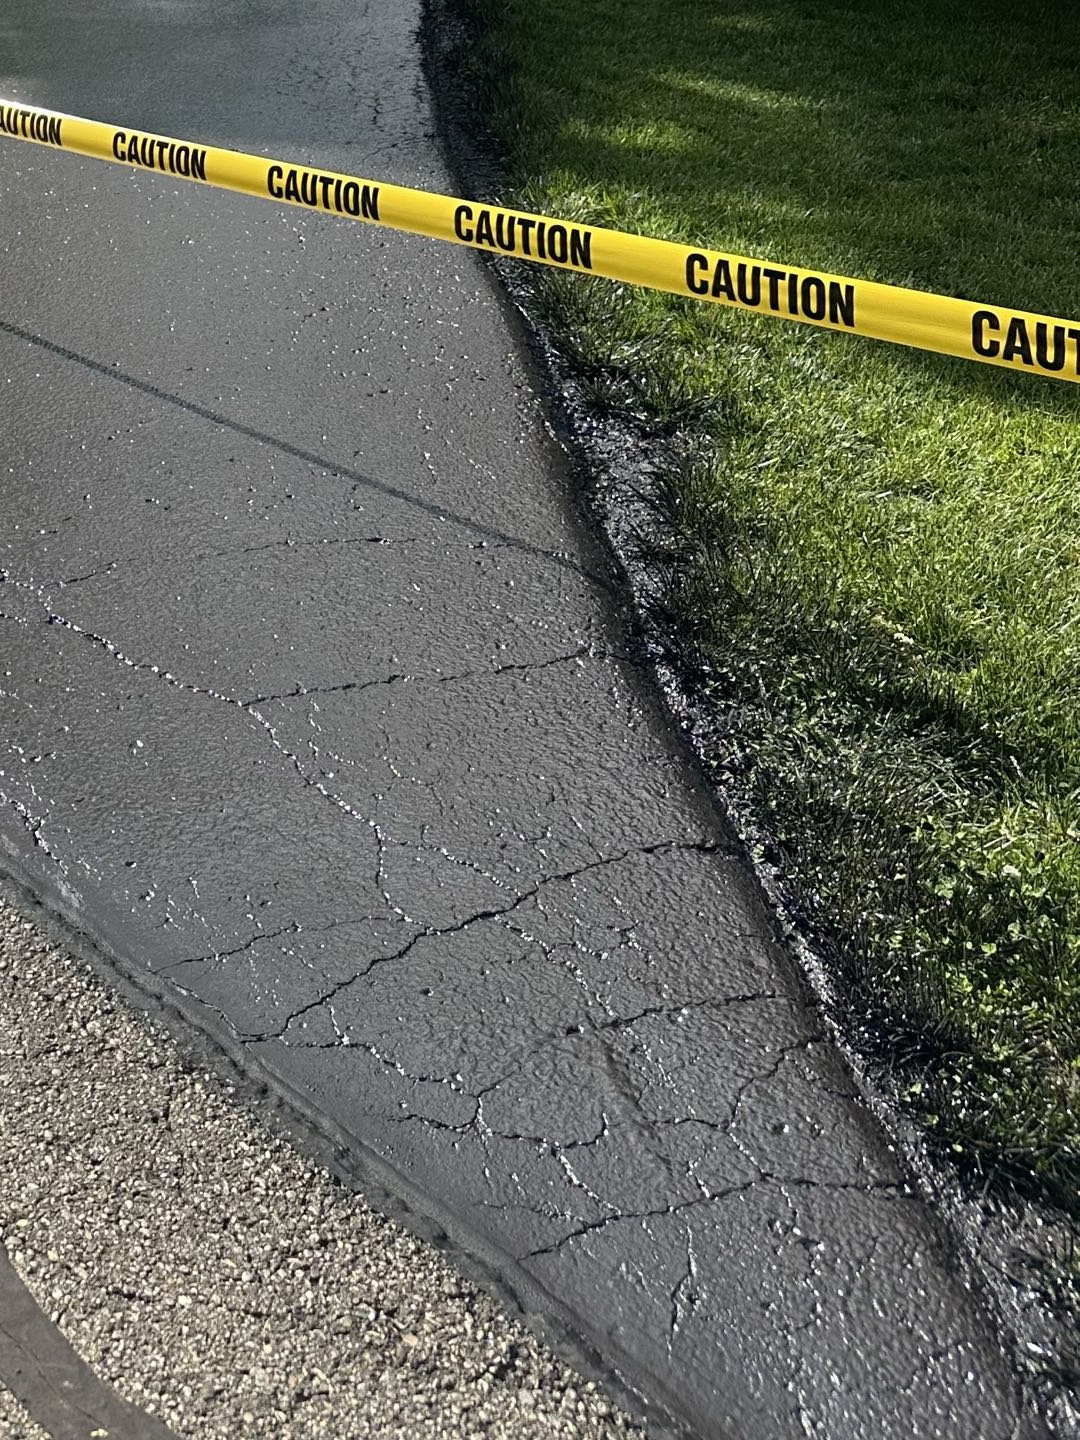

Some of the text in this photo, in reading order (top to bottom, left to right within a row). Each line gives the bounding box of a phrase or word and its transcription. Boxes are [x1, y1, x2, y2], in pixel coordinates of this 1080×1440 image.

[112, 131, 207, 181] CAUTION
[267, 166, 380, 221] CAUTION
[454, 205, 592, 270] CAUTION
[685, 253, 855, 327] CAUTION
